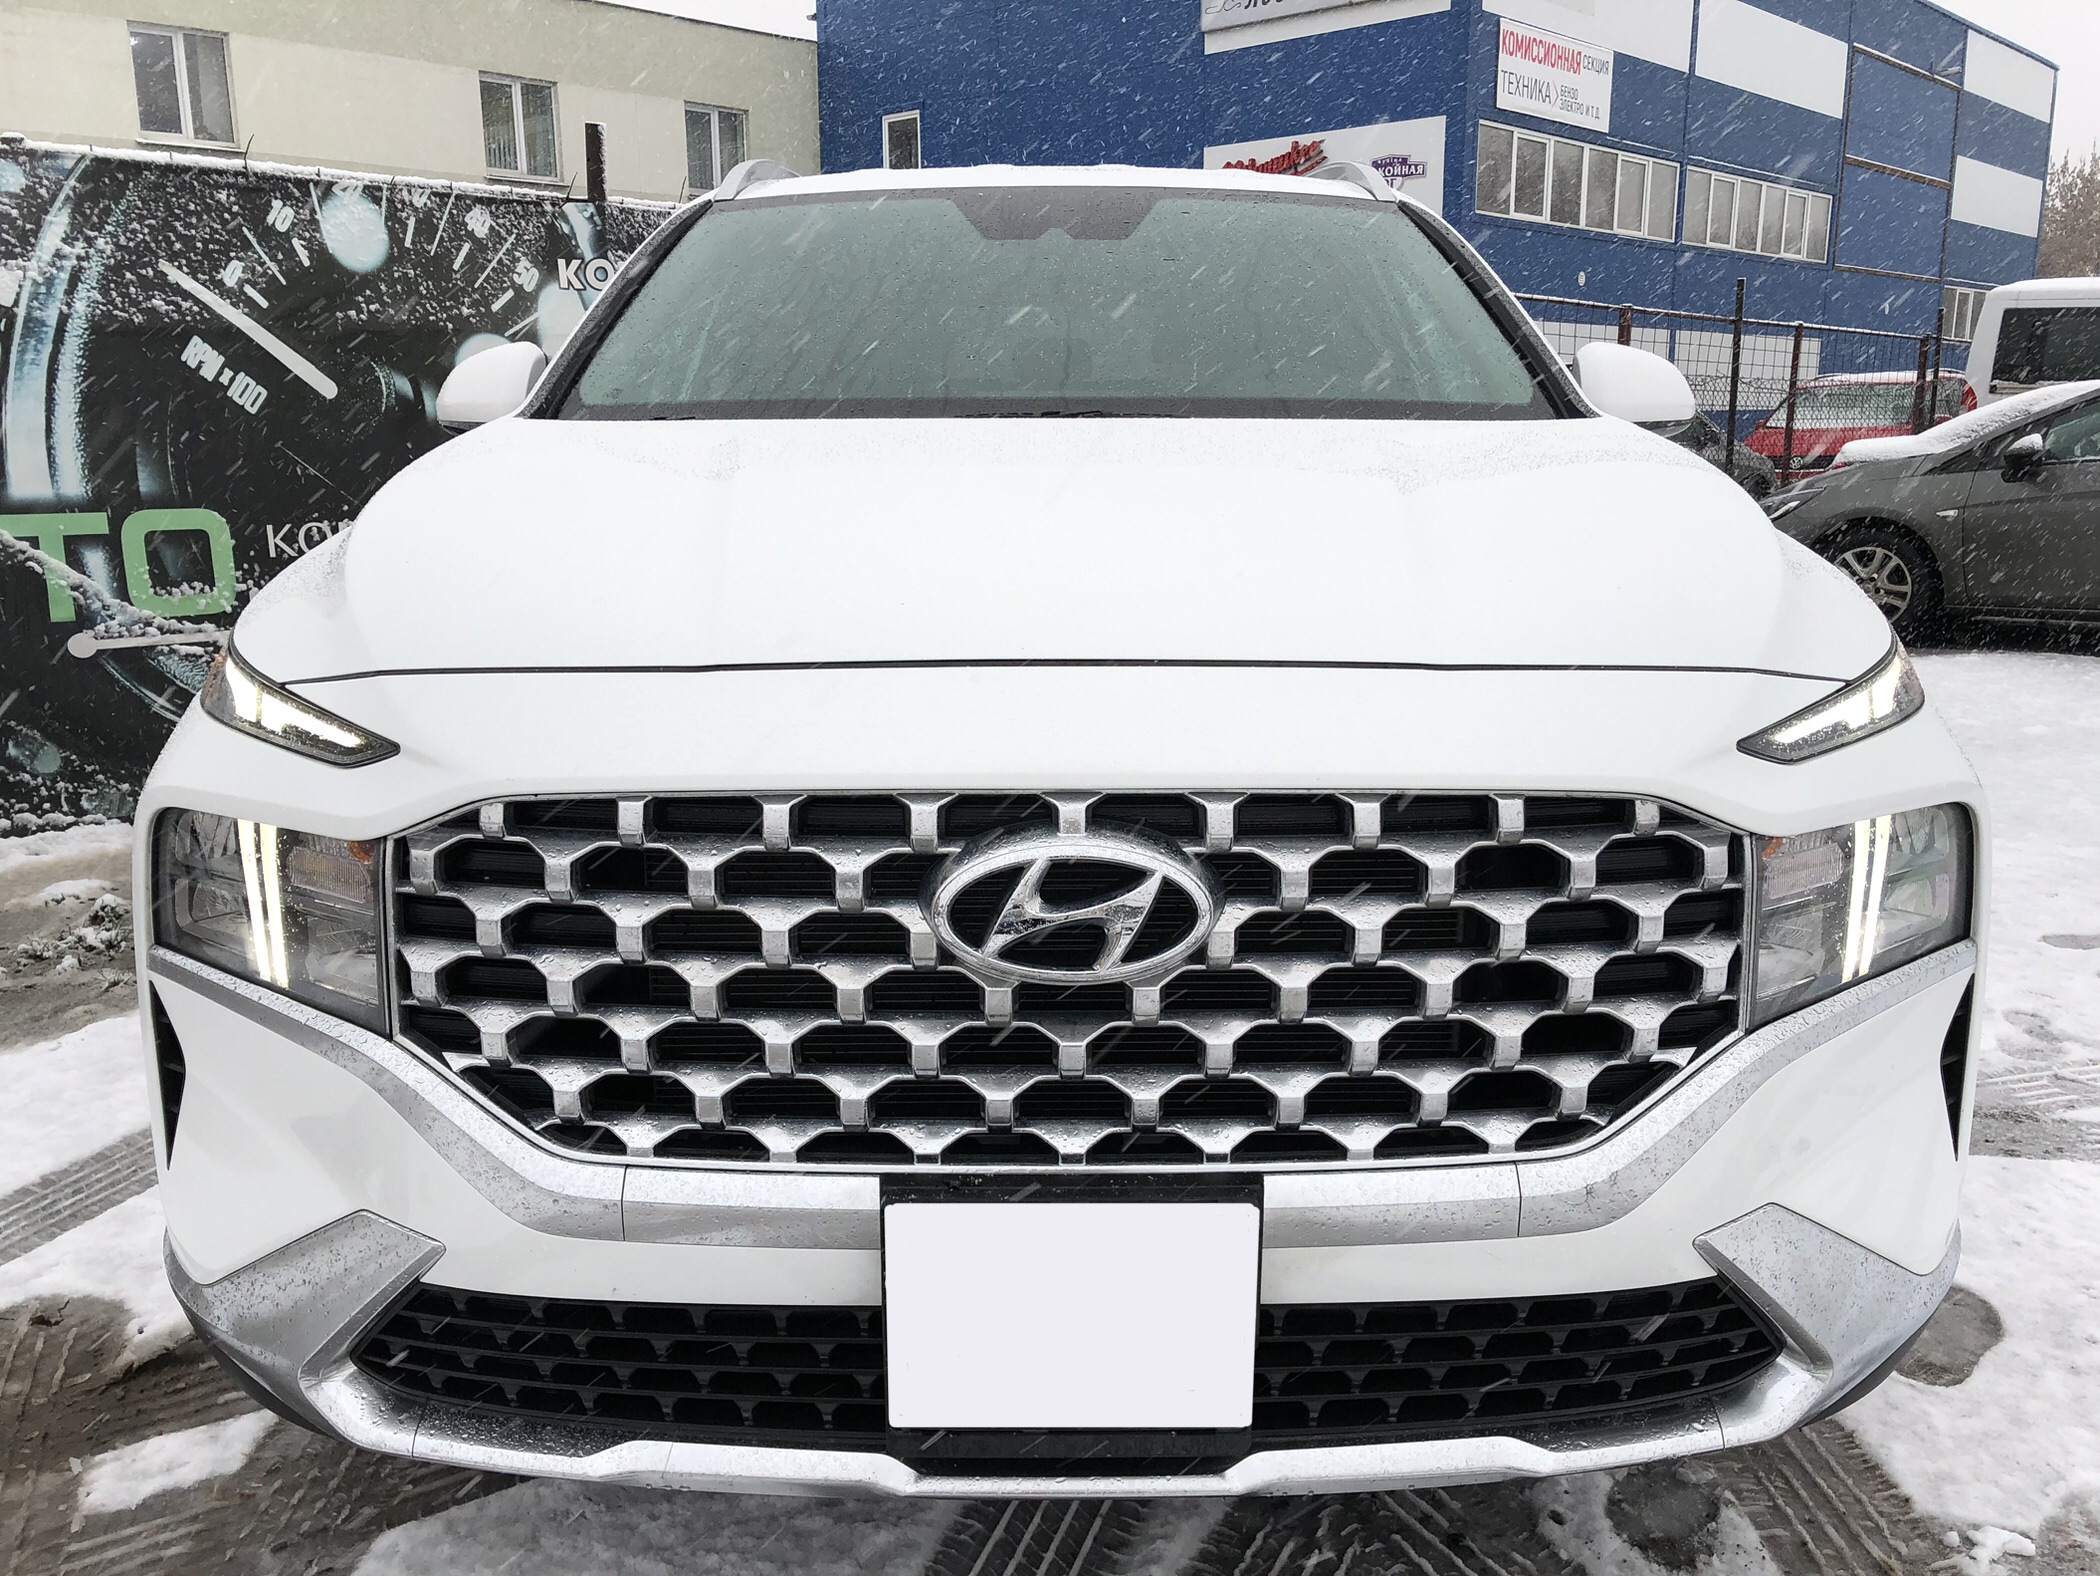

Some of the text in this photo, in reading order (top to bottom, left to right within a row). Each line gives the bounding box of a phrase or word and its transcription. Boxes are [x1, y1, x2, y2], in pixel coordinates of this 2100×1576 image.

[1501, 29, 1610, 75] КОМИССИОННАЯ СЕКЦИЯ
[1501, 69, 1552, 105] ТЕХНИКА
[1560, 85, 1579, 101] БЕНЗО
[1559, 98, 1584, 116] ЭЛЕКТРО
[266, 199, 295, 233] 10
[223, 260, 243, 287] 0
[512, 257, 540, 293] 50
[181, 335, 225, 382] RPM
[227, 371, 268, 415] 100
